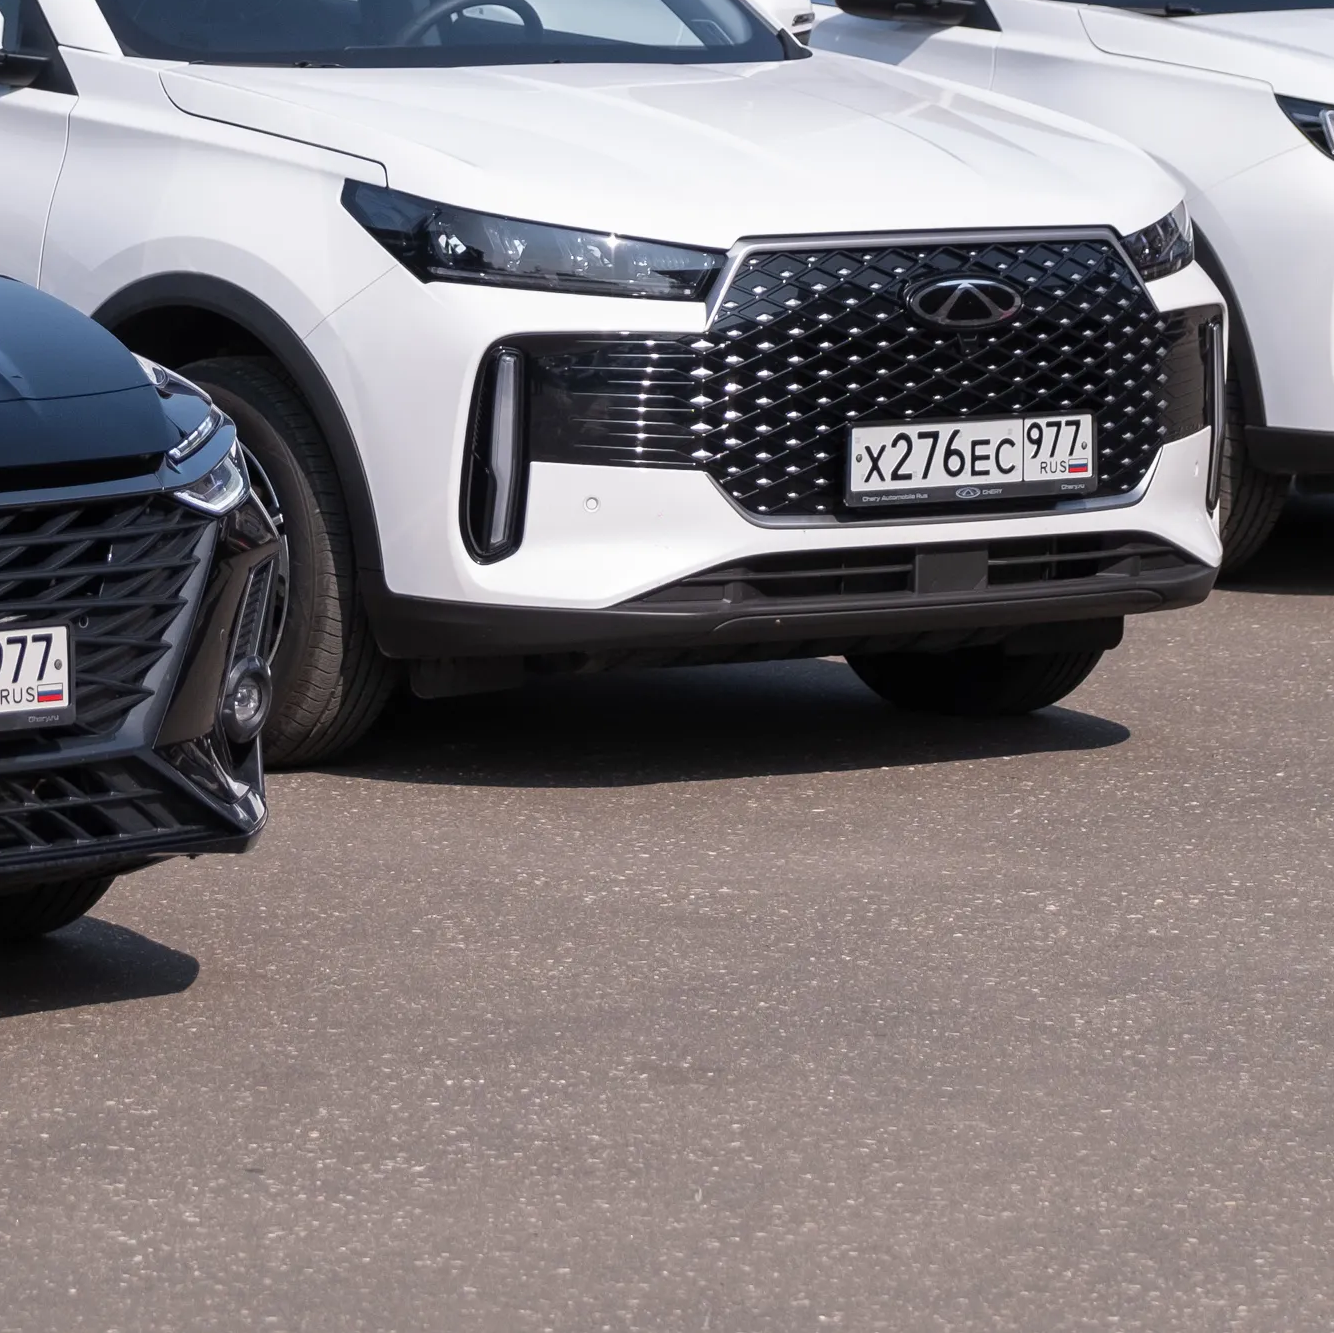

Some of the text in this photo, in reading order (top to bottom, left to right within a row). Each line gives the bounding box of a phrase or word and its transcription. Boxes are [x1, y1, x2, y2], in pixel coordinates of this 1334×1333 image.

[1026, 419, 1081, 460] 977
[1039, 460, 1067, 474] RUS
[862, 495, 881, 504] Chery
[881, 493, 915, 502] Automobile
[0, 686, 36, 705] RUS
